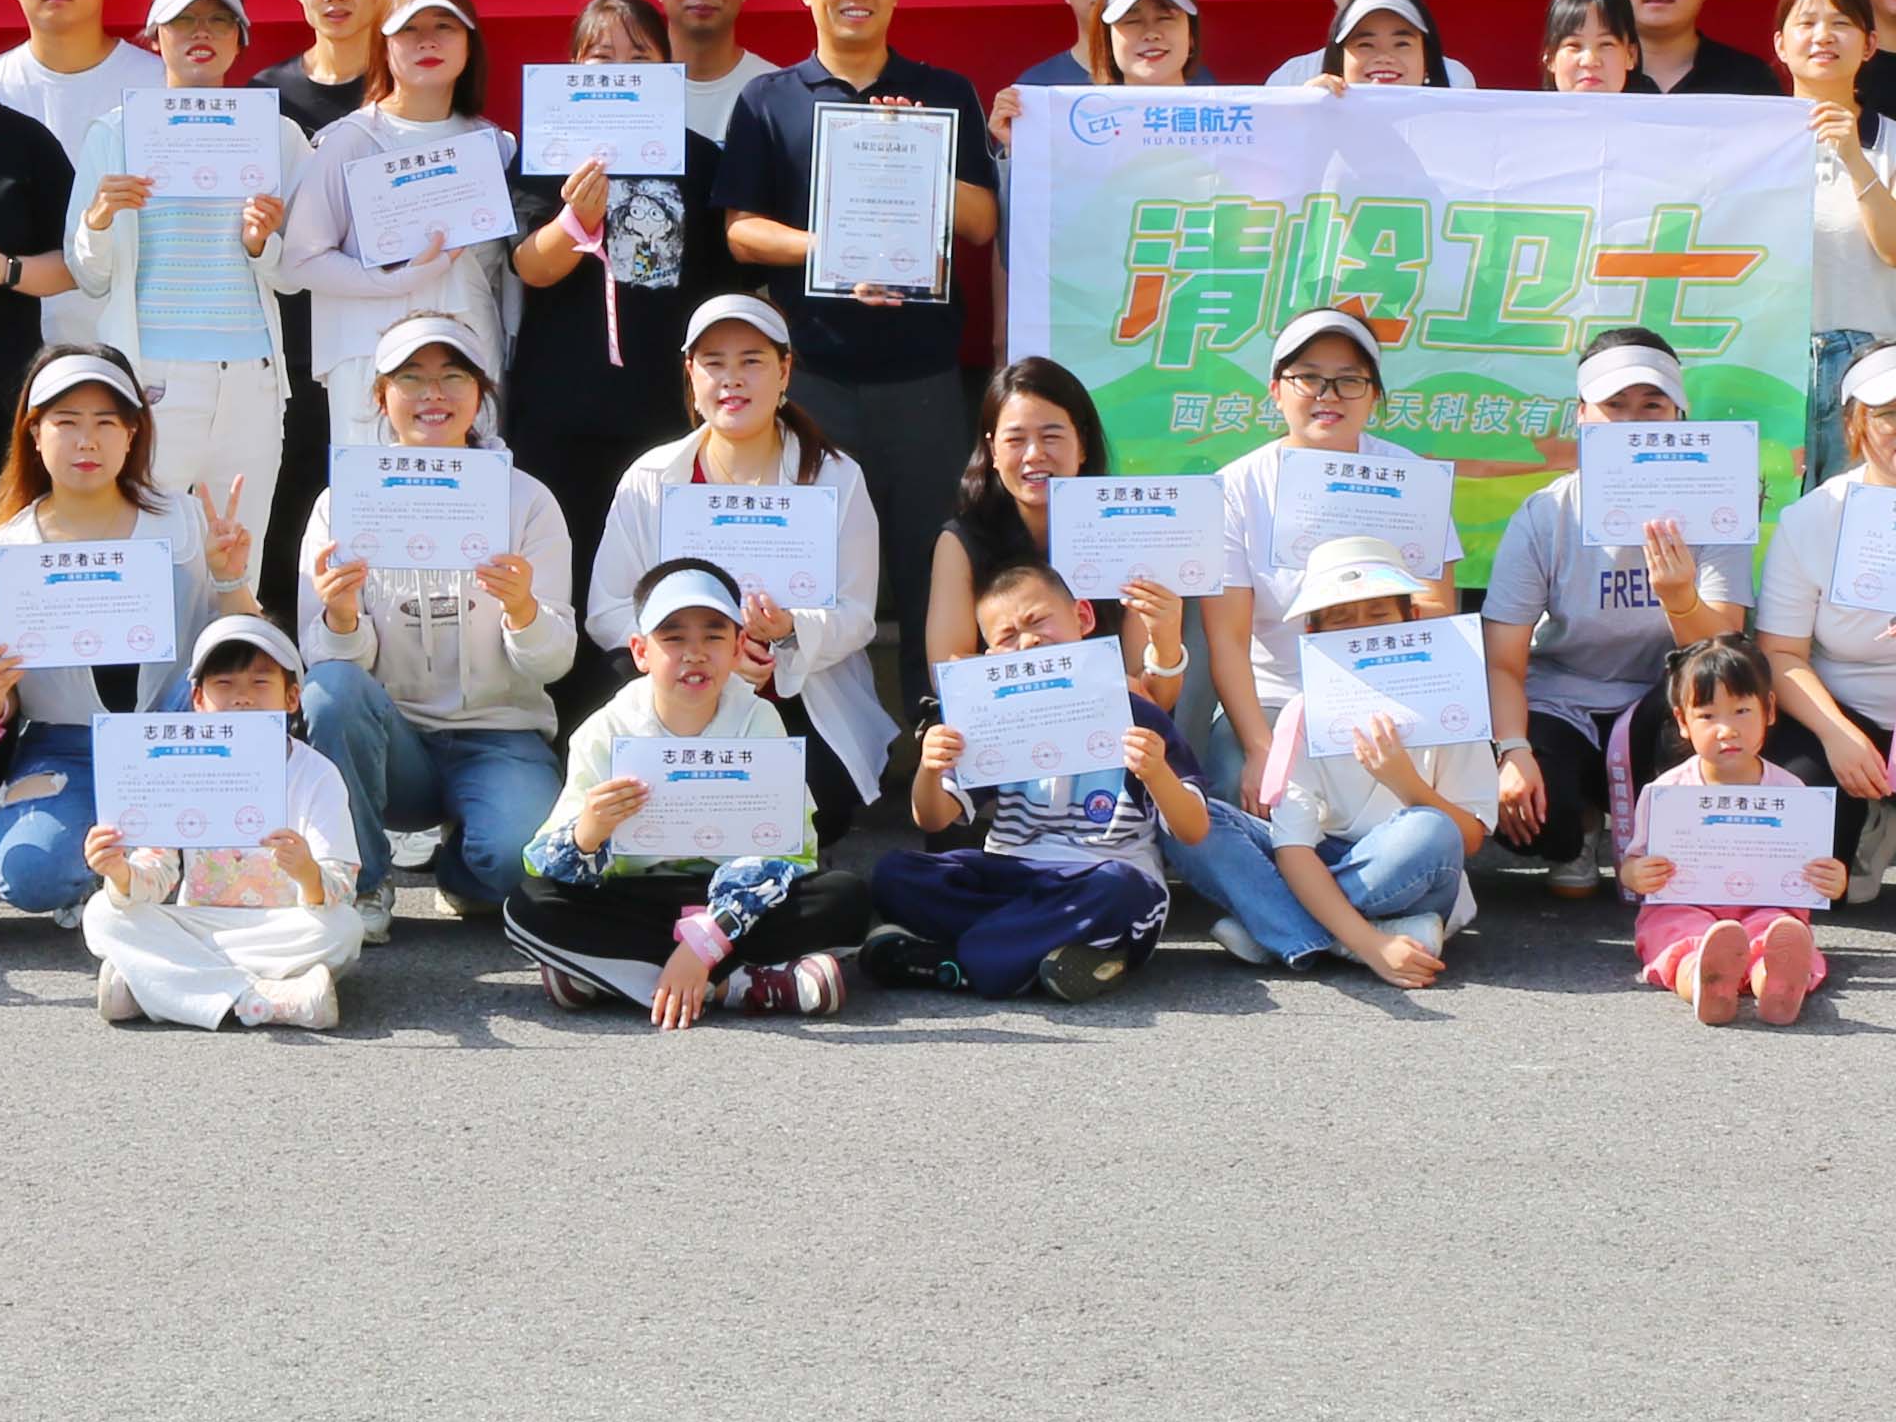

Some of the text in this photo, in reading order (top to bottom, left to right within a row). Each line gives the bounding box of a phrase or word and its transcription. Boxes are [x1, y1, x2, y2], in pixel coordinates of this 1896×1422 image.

[566, 75, 641, 87] 志愿者证书
[165, 98, 237, 110] 志愿者证书
[1143, 106, 1253, 132] 华德航天
[385, 148, 456, 173] 志愿者证书
[1629, 434, 1710, 446] 志愿者证书
[379, 458, 462, 472] 志愿者证书
[1325, 462, 1406, 481] 志愿者证书
[1096, 488, 1178, 501] 志愿者证书
[709, 496, 790, 510] 志愿者证书
[40, 552, 123, 567] 志愿者证书
[1348, 632, 1432, 654] 志愿者证书
[987, 656, 1072, 682] 志愿者证书
[144, 724, 232, 739] 志愿者证书
[662, 750, 752, 764] 志愿者证书
[1699, 796, 1784, 810] 志愿者证书
